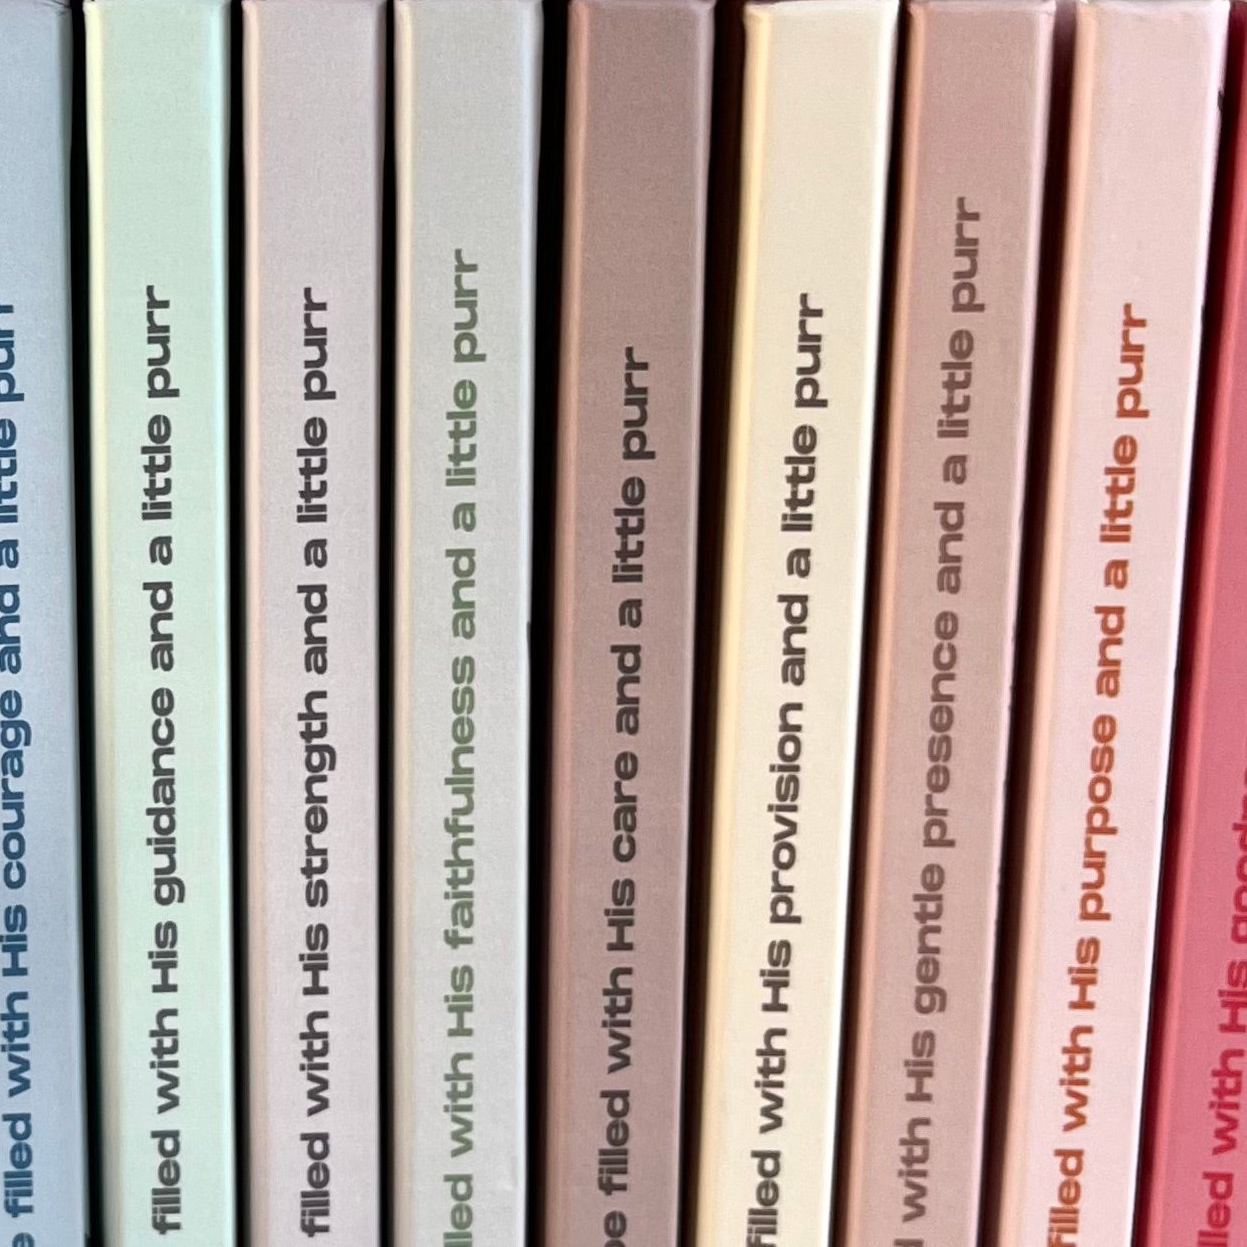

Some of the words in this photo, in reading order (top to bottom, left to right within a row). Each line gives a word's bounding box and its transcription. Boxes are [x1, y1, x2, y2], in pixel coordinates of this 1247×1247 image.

[454, 249, 486, 363] purr
[952, 197, 986, 312] purr
[146, 285, 180, 398] purr
[304, 287, 336, 401] purr
[795, 293, 828, 408] purr
[937, 329, 974, 438] little
[1116, 303, 1150, 418] purr
[445, 379, 477, 486] little
[622, 346, 656, 460] purr
[141, 414, 172, 521] little
[297, 417, 327, 523] little
[453, 502, 476, 532] a
[781, 424, 817, 532] little
[943, 455, 968, 485] a
[1099, 435, 1138, 543] little
[149, 536, 173, 565] a
[304, 538, 327, 568] a
[612, 477, 646, 583] little
[787, 548, 811, 578] a
[933, 501, 965, 594] and
[1104, 559, 1129, 589] a
[143, 581, 174, 671] and
[297, 584, 327, 675] and
[445, 548, 476, 640] and
[619, 599, 642, 628] a
[777, 594, 809, 686] and
[610, 644, 642, 736] and
[1094, 606, 1125, 698] and
[923, 611, 959, 848] presence
[0, 690, 32, 889] courage
[146, 687, 185, 906] guidance
[297, 690, 336, 907] strength
[443, 656, 475, 950] faithfulness
[613, 751, 638, 863] care
[767, 702, 803, 924] provision
[1079, 714, 1118, 921] purpose
[148, 921, 178, 993] His
[299, 923, 329, 996] His
[604, 878, 635, 951] His
[912, 864, 947, 1015] gentle
[444, 965, 474, 1037] His
[601, 967, 633, 1074] with
[759, 940, 792, 1012] His
[1067, 937, 1100, 1010] His
[1218, 959, 1247, 1034] His
[0, 991, 31, 1098] with
[149, 1008, 180, 1114] with
[299, 1011, 329, 1117] with
[754, 1028, 787, 1134] with
[904, 1030, 936, 1102] His
[1059, 1025, 1094, 1132] with
[443, 1053, 474, 1158] with
[598, 1090, 630, 1196] filled
[1208, 1049, 1245, 1155] with
[2, 1113, 33, 1218] filled
[151, 1130, 181, 1235] filled
[300, 1132, 330, 1238] filled
[443, 1174, 473, 1247] lled
[897, 1117, 931, 1223] with
[1197, 1171, 1234, 1247] lled
